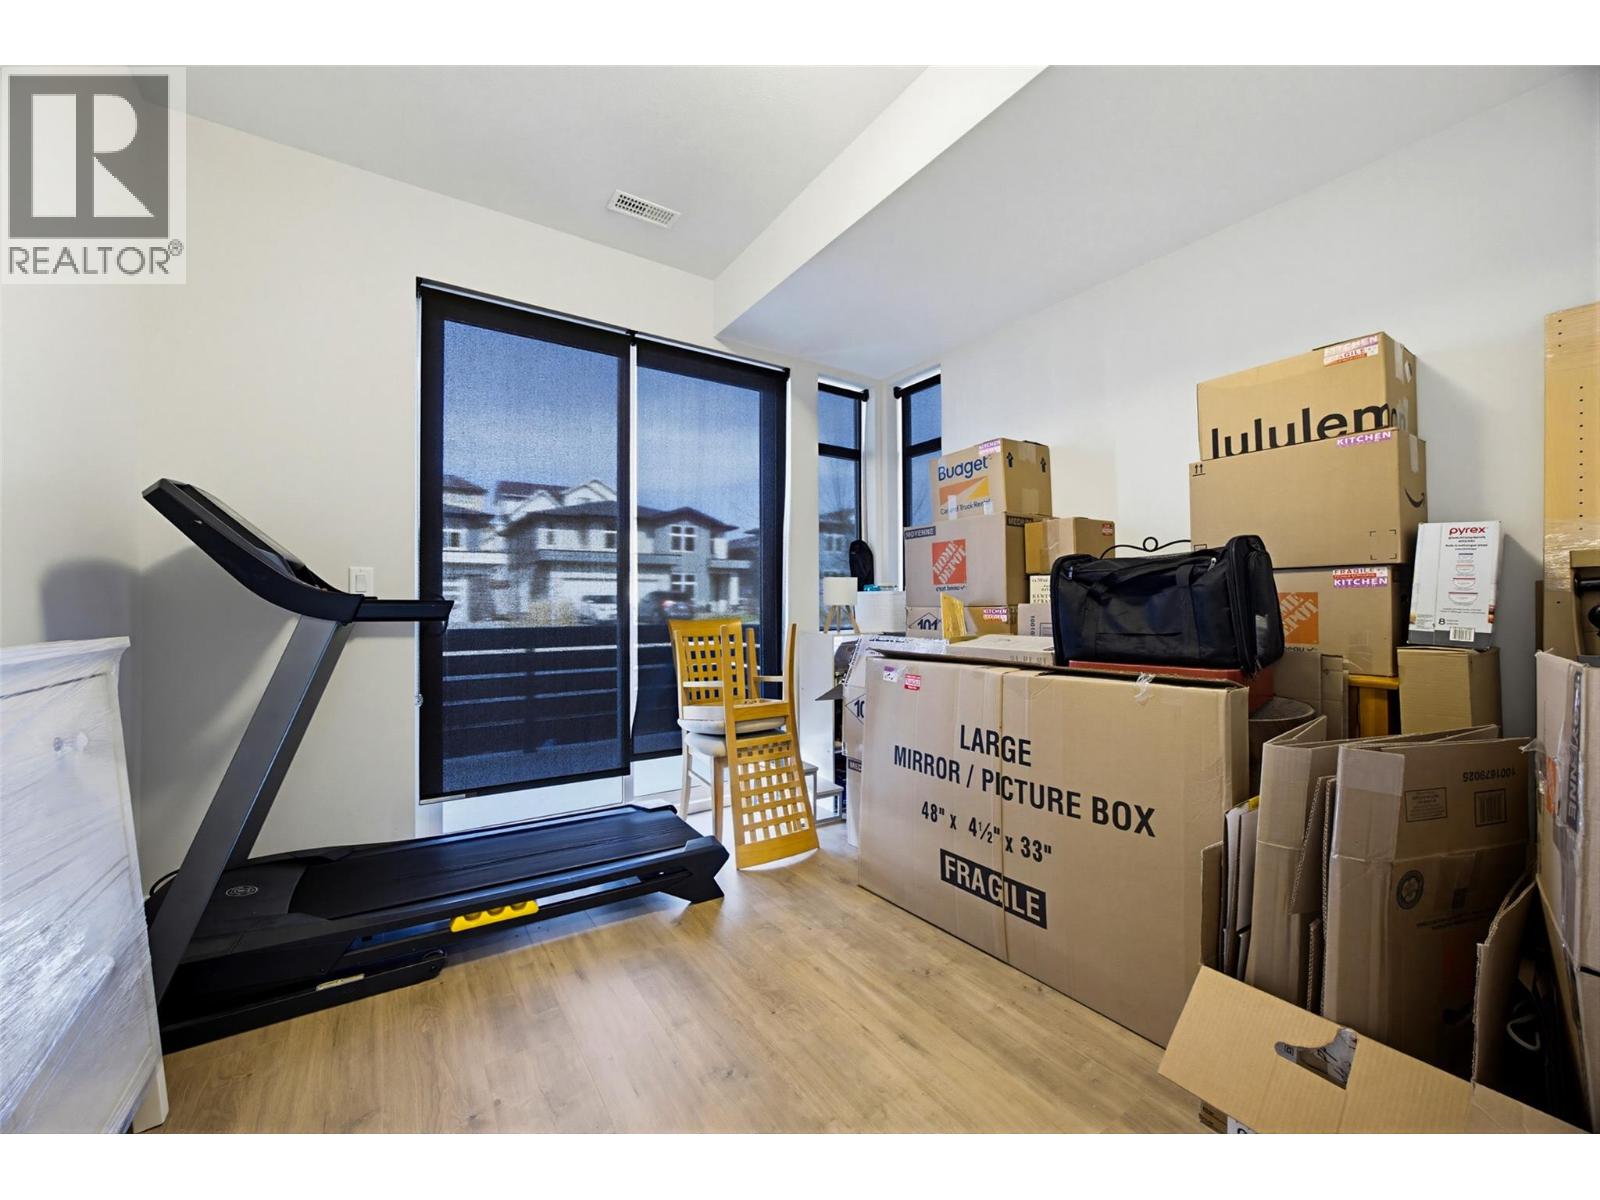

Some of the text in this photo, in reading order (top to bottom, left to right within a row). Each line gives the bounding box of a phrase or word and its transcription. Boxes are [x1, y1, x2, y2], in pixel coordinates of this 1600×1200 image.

[1336, 431, 1391, 446] KITCHEN
[938, 456, 988, 481] Budget
[1449, 526, 1486, 536] pyrex
[932, 541, 958, 575] HOME
[938, 545, 967, 584] DEPOT
[1334, 578, 1388, 587] KITCHEN
[917, 619, 938, 631] 101
[960, 724, 1032, 767] LARGE
[894, 744, 1156, 838] MIRROR / PICTURE BOX
[921, 801, 945, 824] 48"
[1020, 836, 1052, 863] 33"
[944, 855, 1042, 922] FRAGILE
